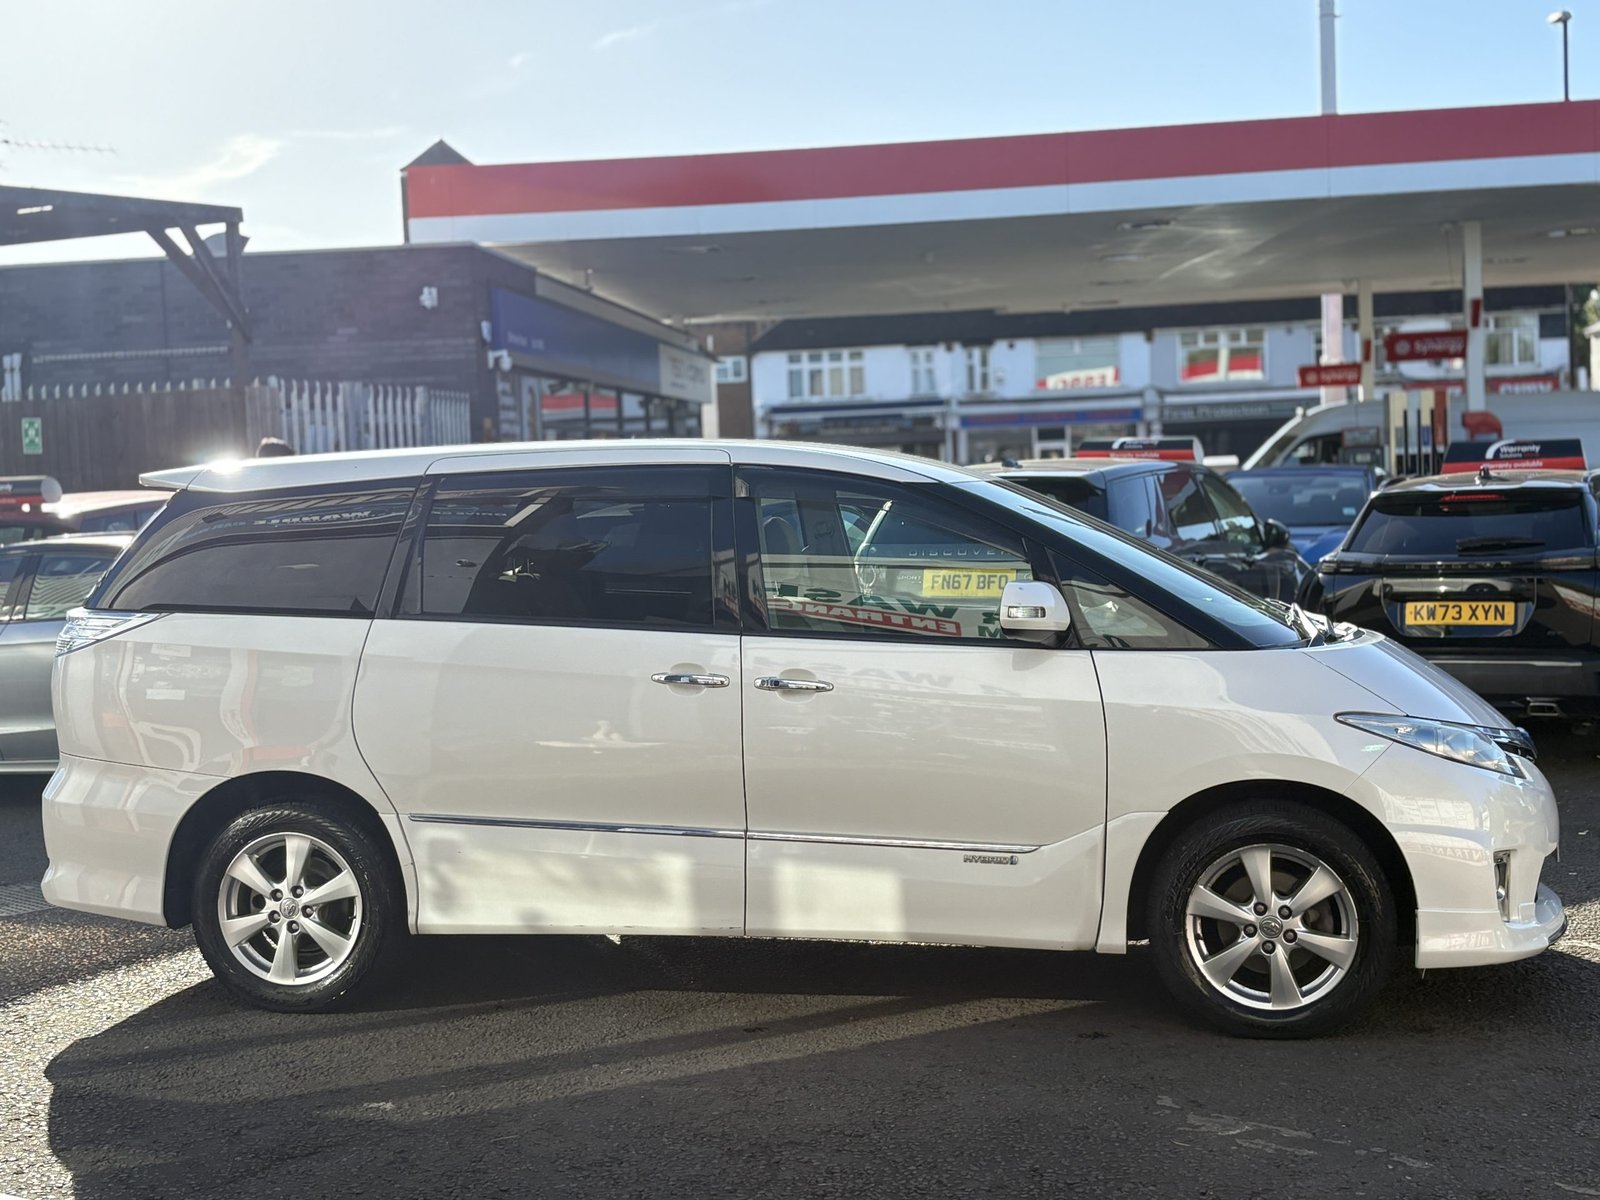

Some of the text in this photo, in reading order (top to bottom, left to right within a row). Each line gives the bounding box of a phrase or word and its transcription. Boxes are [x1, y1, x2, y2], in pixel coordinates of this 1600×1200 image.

[1500, 444, 1541, 453] Warranty
[931, 574, 971, 590] FN67
[1413, 604, 1506, 622] KW73 XYN
